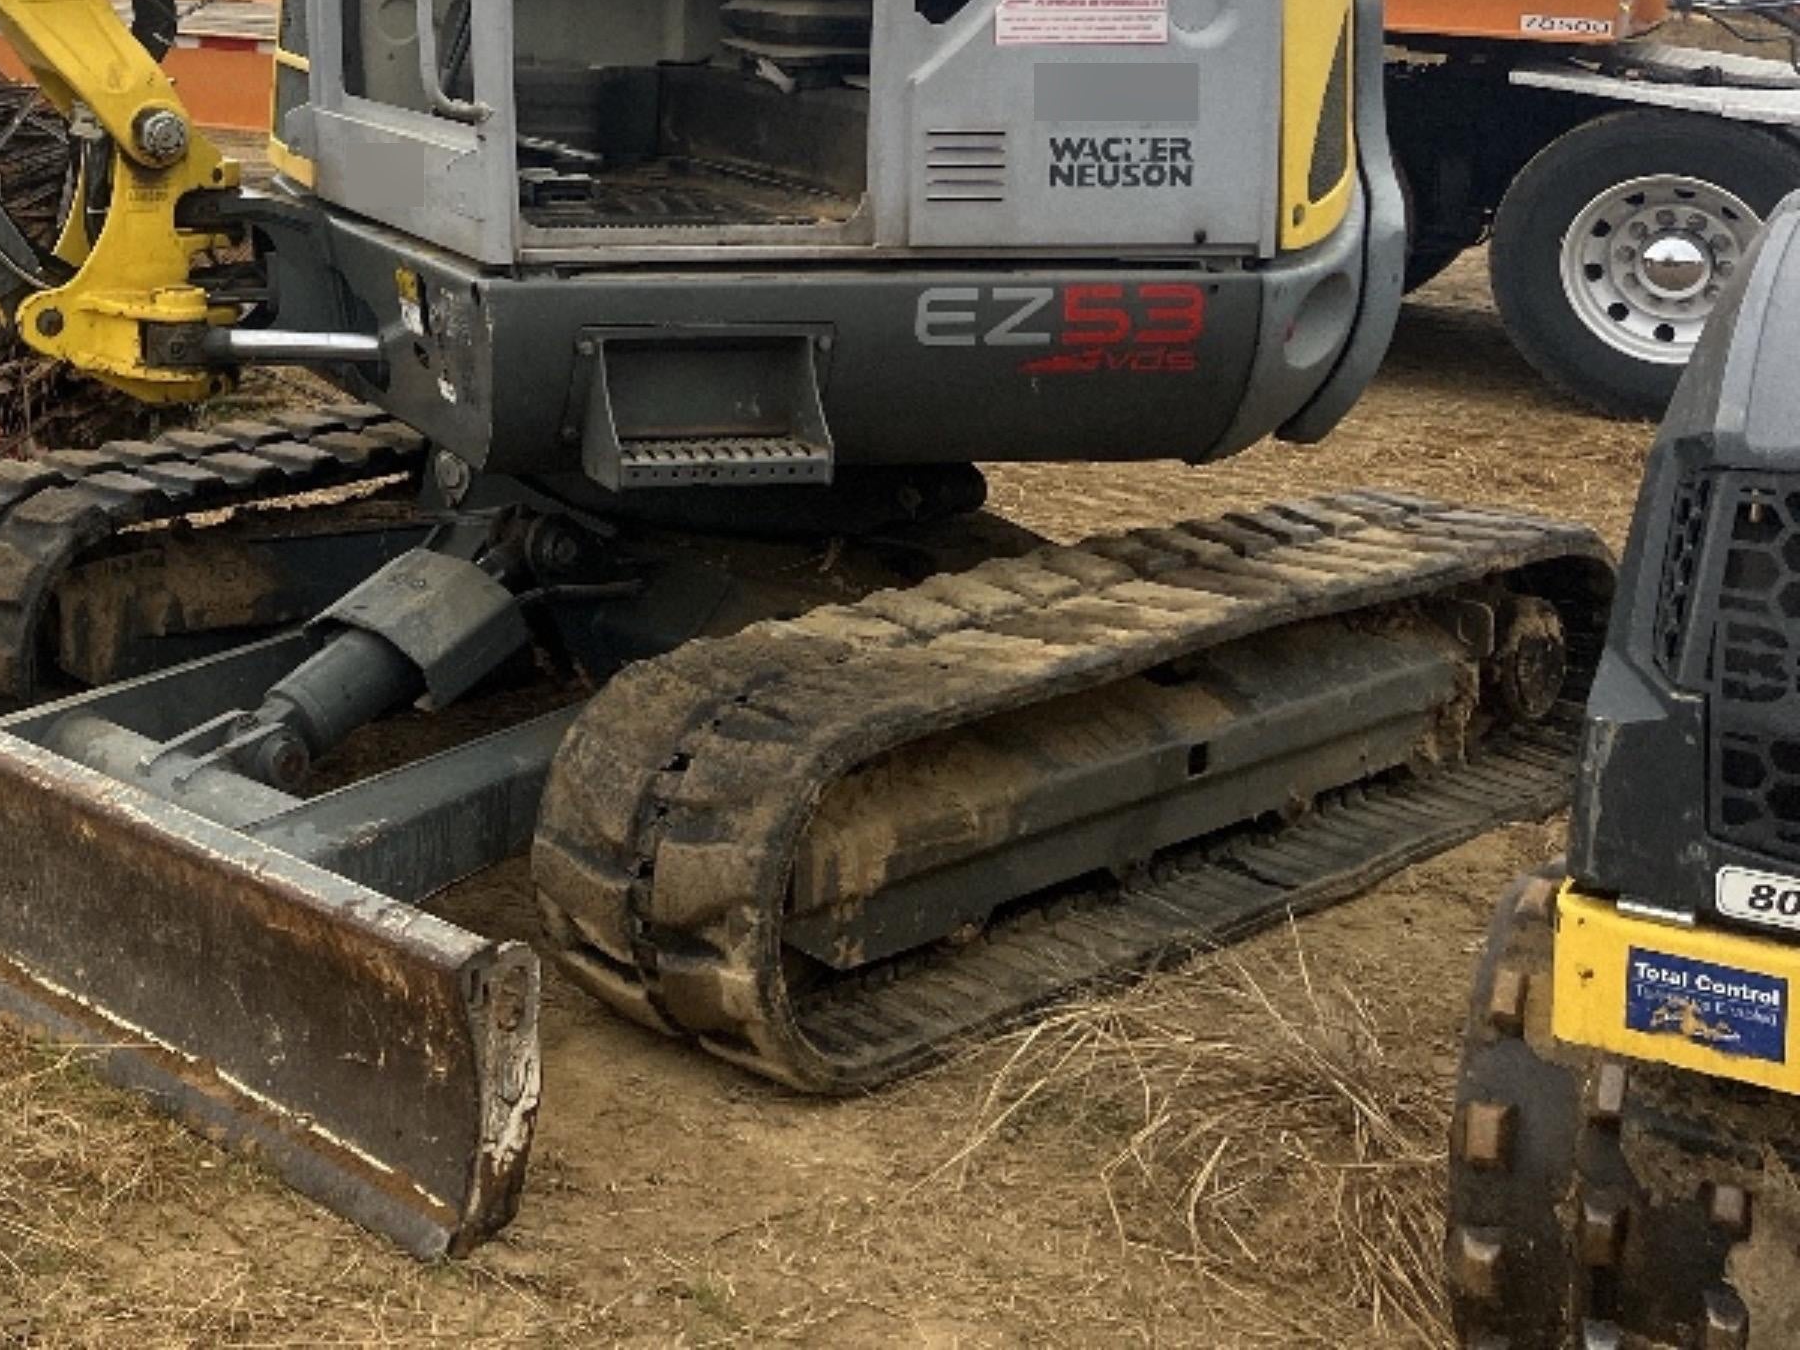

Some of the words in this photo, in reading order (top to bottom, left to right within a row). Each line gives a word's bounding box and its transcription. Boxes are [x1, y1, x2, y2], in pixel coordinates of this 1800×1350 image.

[1049, 164, 1194, 188] NEUSON
[914, 282, 1207, 346] EZ53
[1634, 961, 1687, 988] Total
[1695, 974, 1780, 1006] Control
